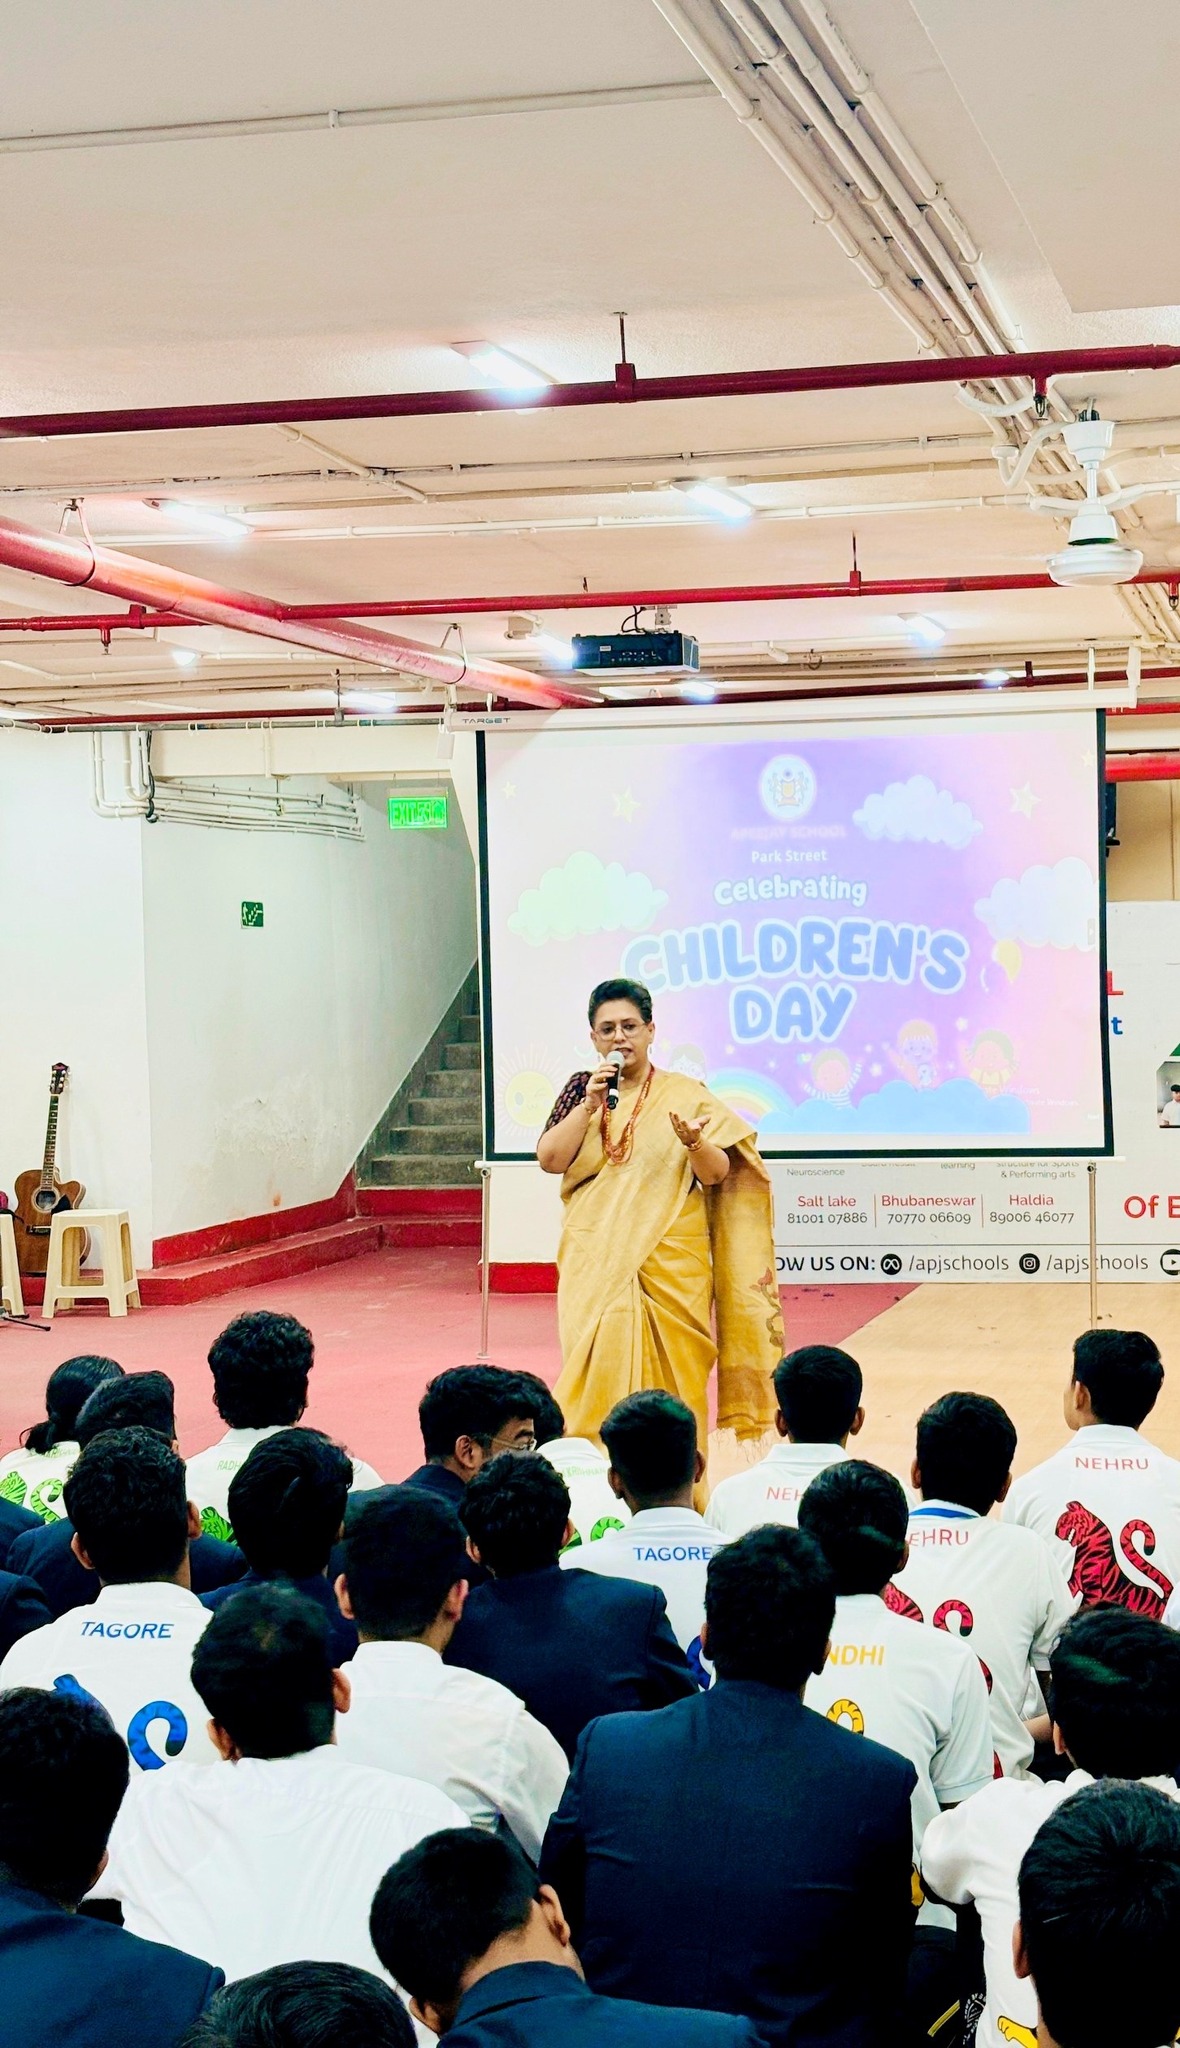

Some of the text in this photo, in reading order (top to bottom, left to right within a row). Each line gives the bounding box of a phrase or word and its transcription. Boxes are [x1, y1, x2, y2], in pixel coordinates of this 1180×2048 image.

[751, 850, 827, 863] Park Street
[714, 874, 868, 907] Celebrating
[622, 918, 968, 993] CHILDREN'S
[731, 984, 855, 1041] DAY
[786, 1168, 845, 1176] Neuroscience
[1009, 1170, 1057, 1179] Performing
[1059, 1170, 1076, 1178] arts
[797, 1195, 857, 1207] Salt lake
[881, 1194, 976, 1206] Bhubaneswar
[1009, 1194, 1054, 1206] Haldia
[1124, 1195, 1180, 1219] Of E
[787, 1212, 868, 1225] 81001 07886
[887, 1211, 971, 1225] 70770 06609
[989, 1211, 1075, 1224] 89006 46077
[811, 1256, 835, 1271] US
[840, 1256, 876, 1271] ON:
[909, 1254, 1009, 1275] /apjschools
[217, 1460, 242, 1471] RADH
[1075, 1457, 1149, 1470] NEHRU
[766, 1486, 803, 1501] NEH
[908, 1528, 969, 1547] EHRU
[633, 1547, 712, 1561] TAGORE
[81, 1621, 174, 1639] TAGORE
[829, 1645, 885, 1666] NDHI
